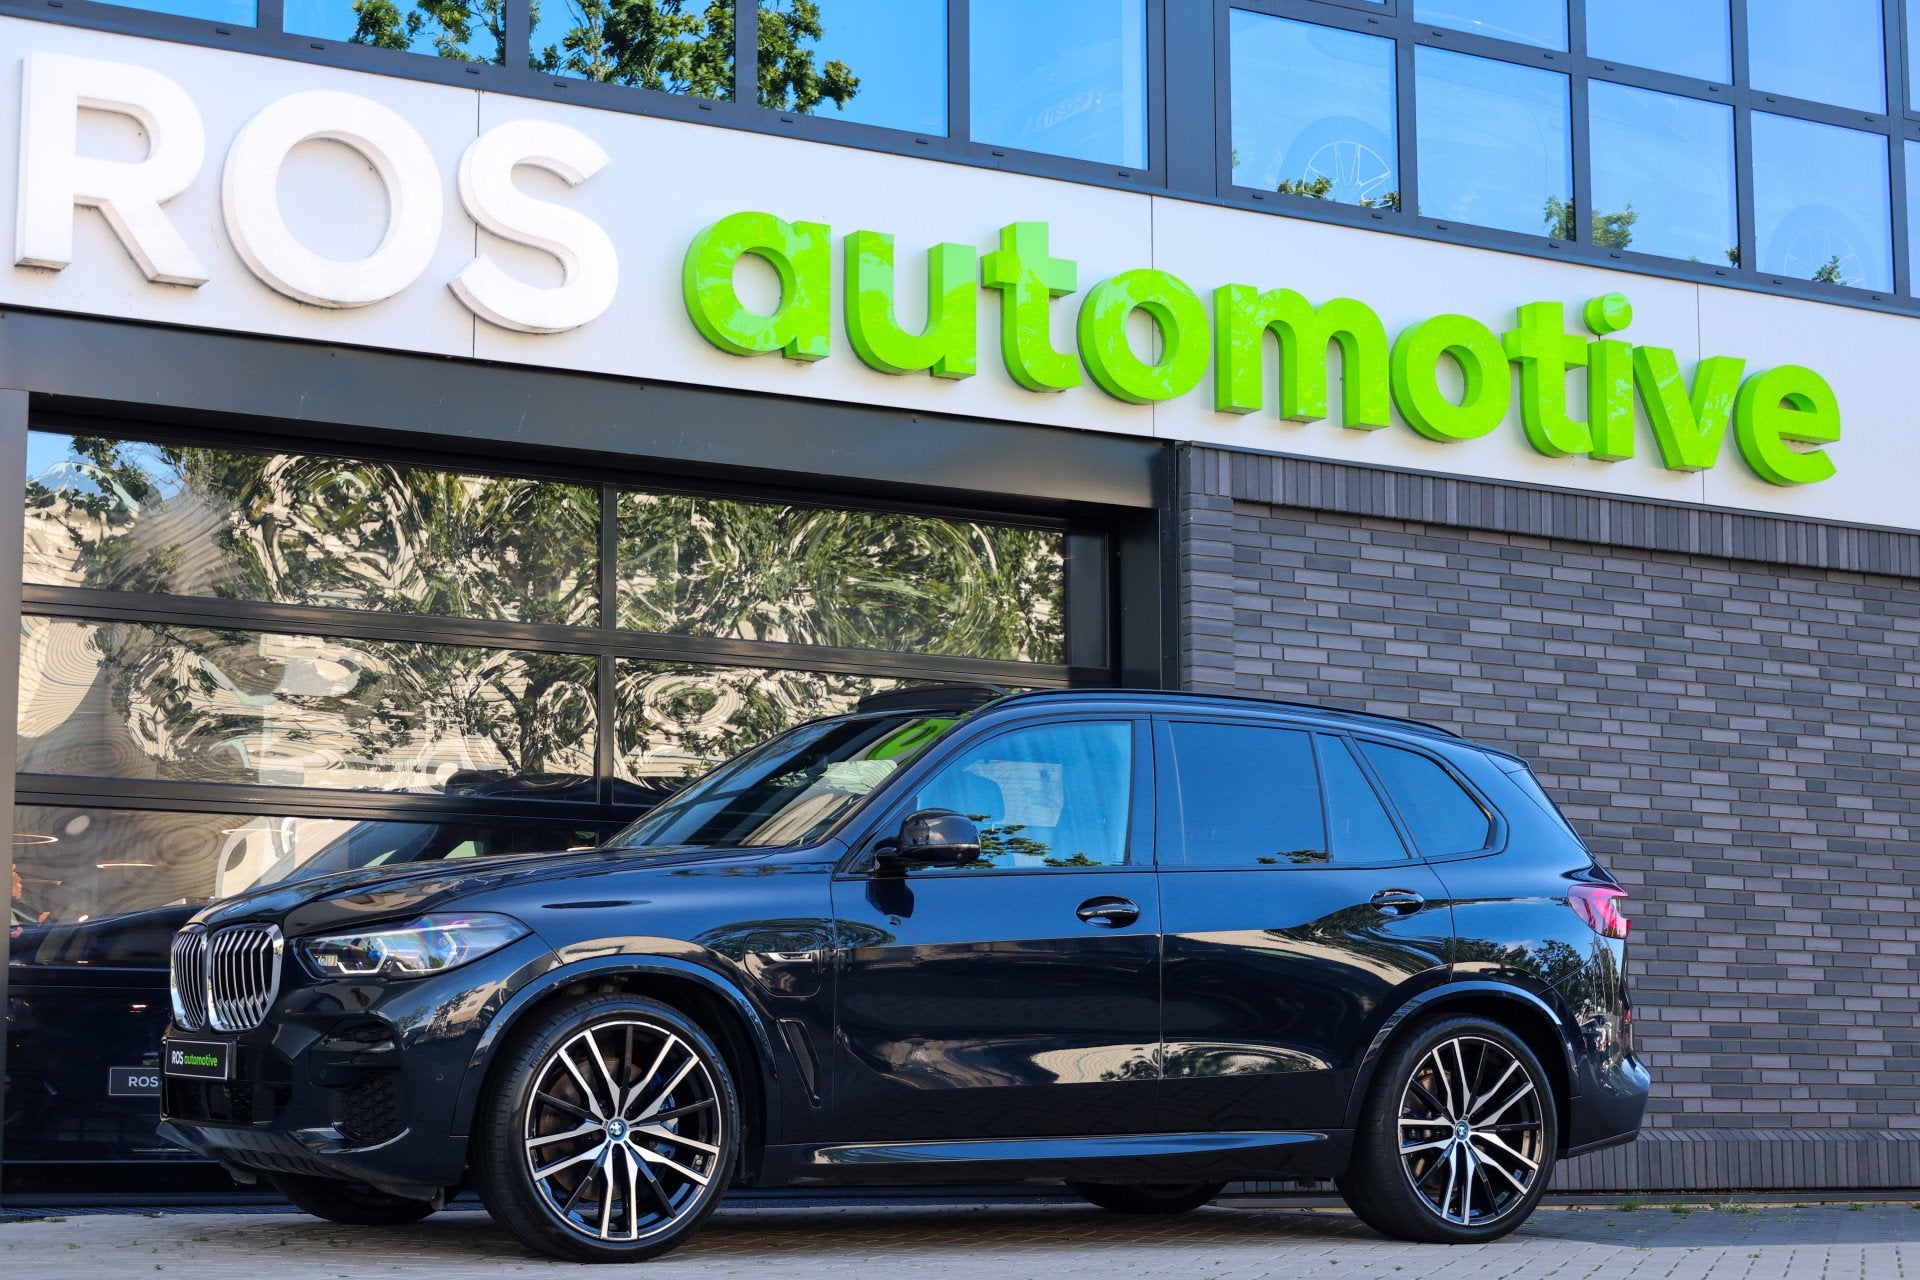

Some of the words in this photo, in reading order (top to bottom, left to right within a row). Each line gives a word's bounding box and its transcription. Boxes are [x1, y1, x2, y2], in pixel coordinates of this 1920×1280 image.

[15, 51, 619, 334] ROS
[682, 211, 1841, 487] automotive
[171, 1050, 184, 1065] ROS
[184, 1053, 218, 1067] automotive
[128, 1076, 159, 1088] ROS
